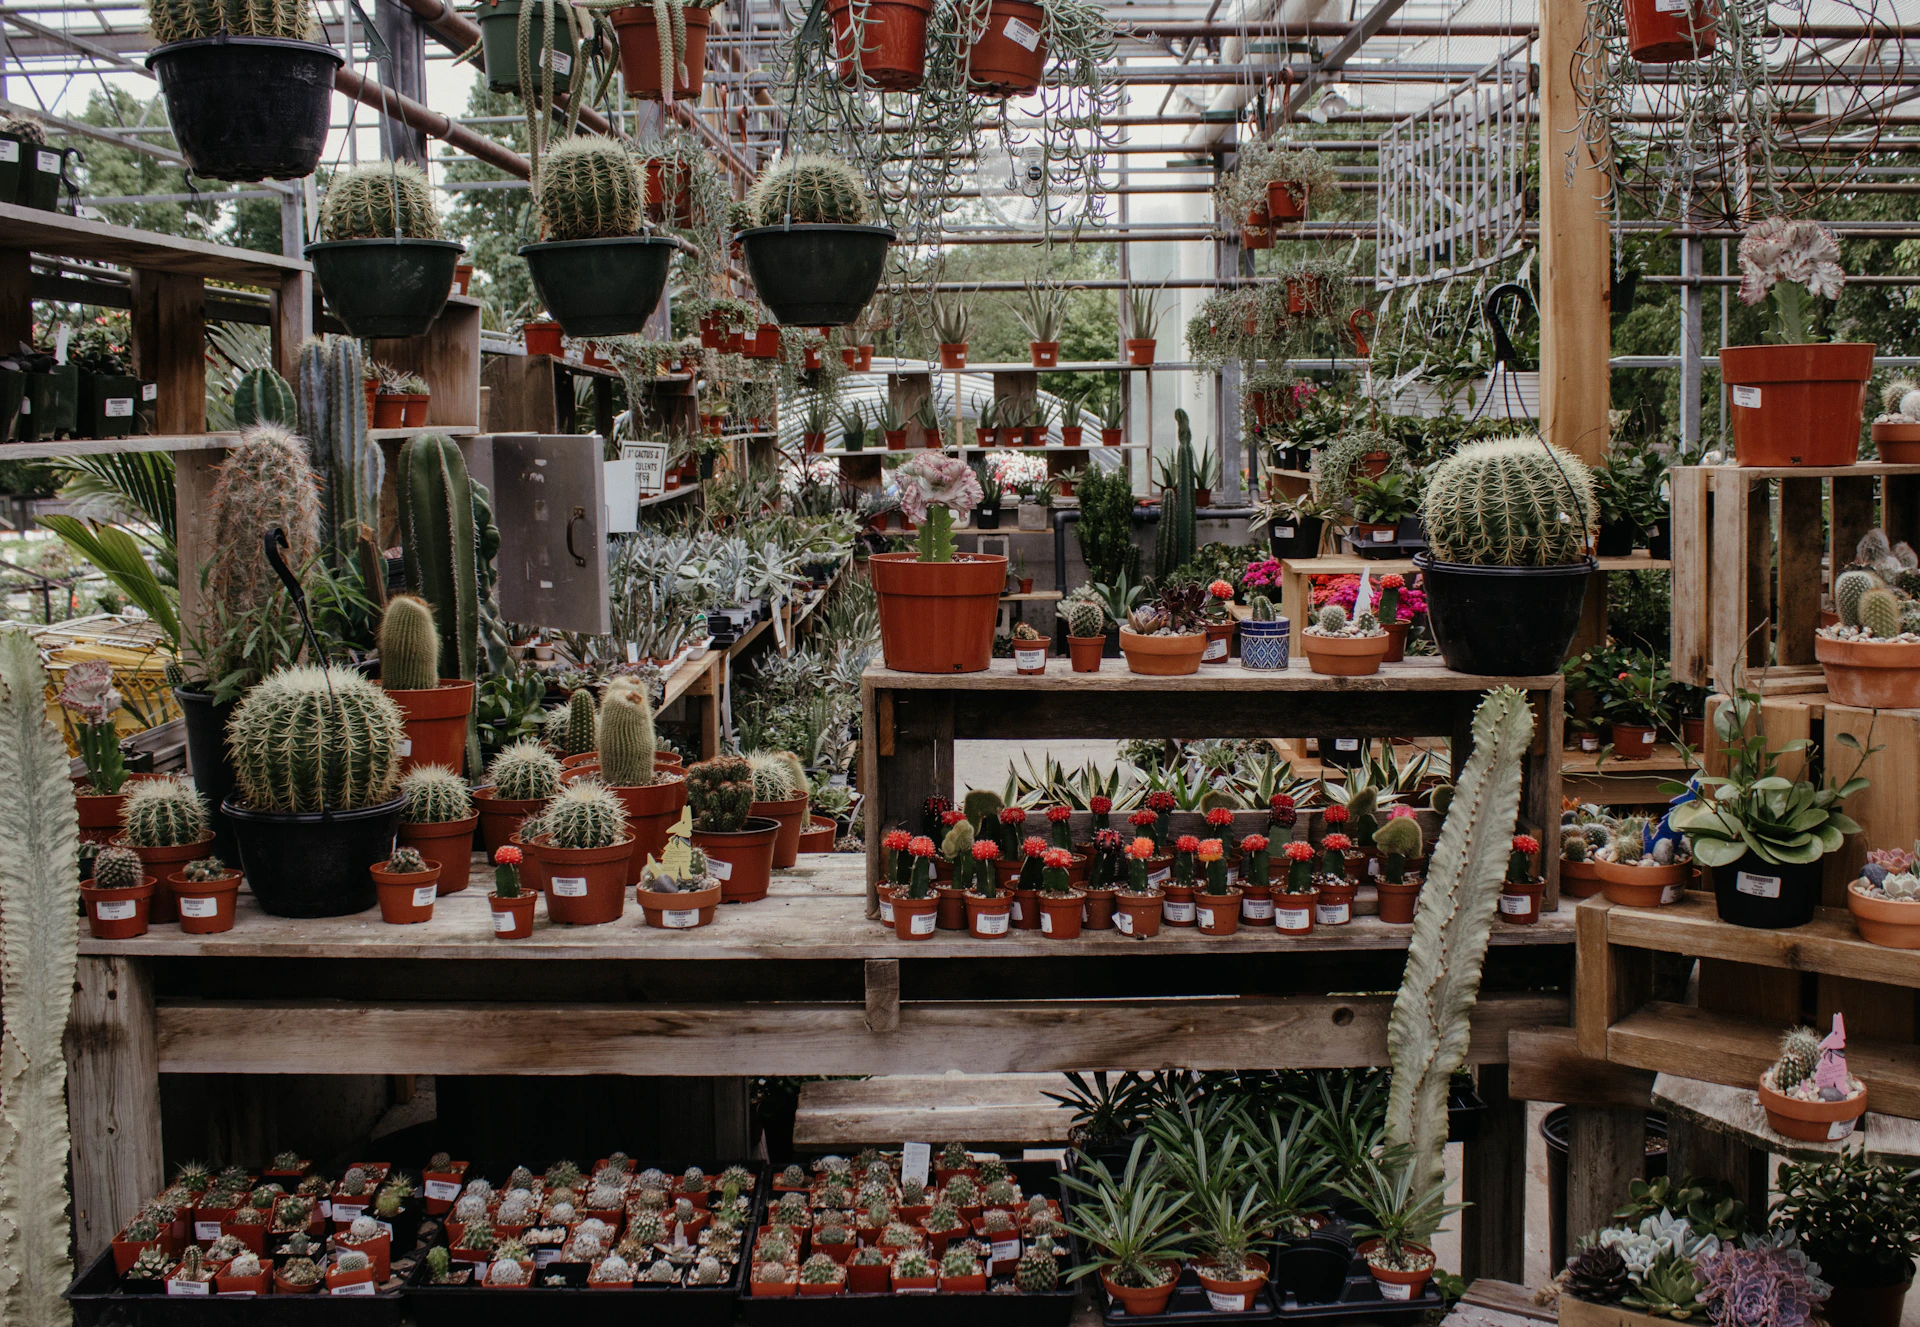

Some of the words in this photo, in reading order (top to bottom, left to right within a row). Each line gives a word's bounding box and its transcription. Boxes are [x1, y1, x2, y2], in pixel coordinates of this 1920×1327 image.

[635, 449, 654, 459] CACTUS
[655, 451, 660, 460] &
[635, 462, 658, 472] CULENTS
